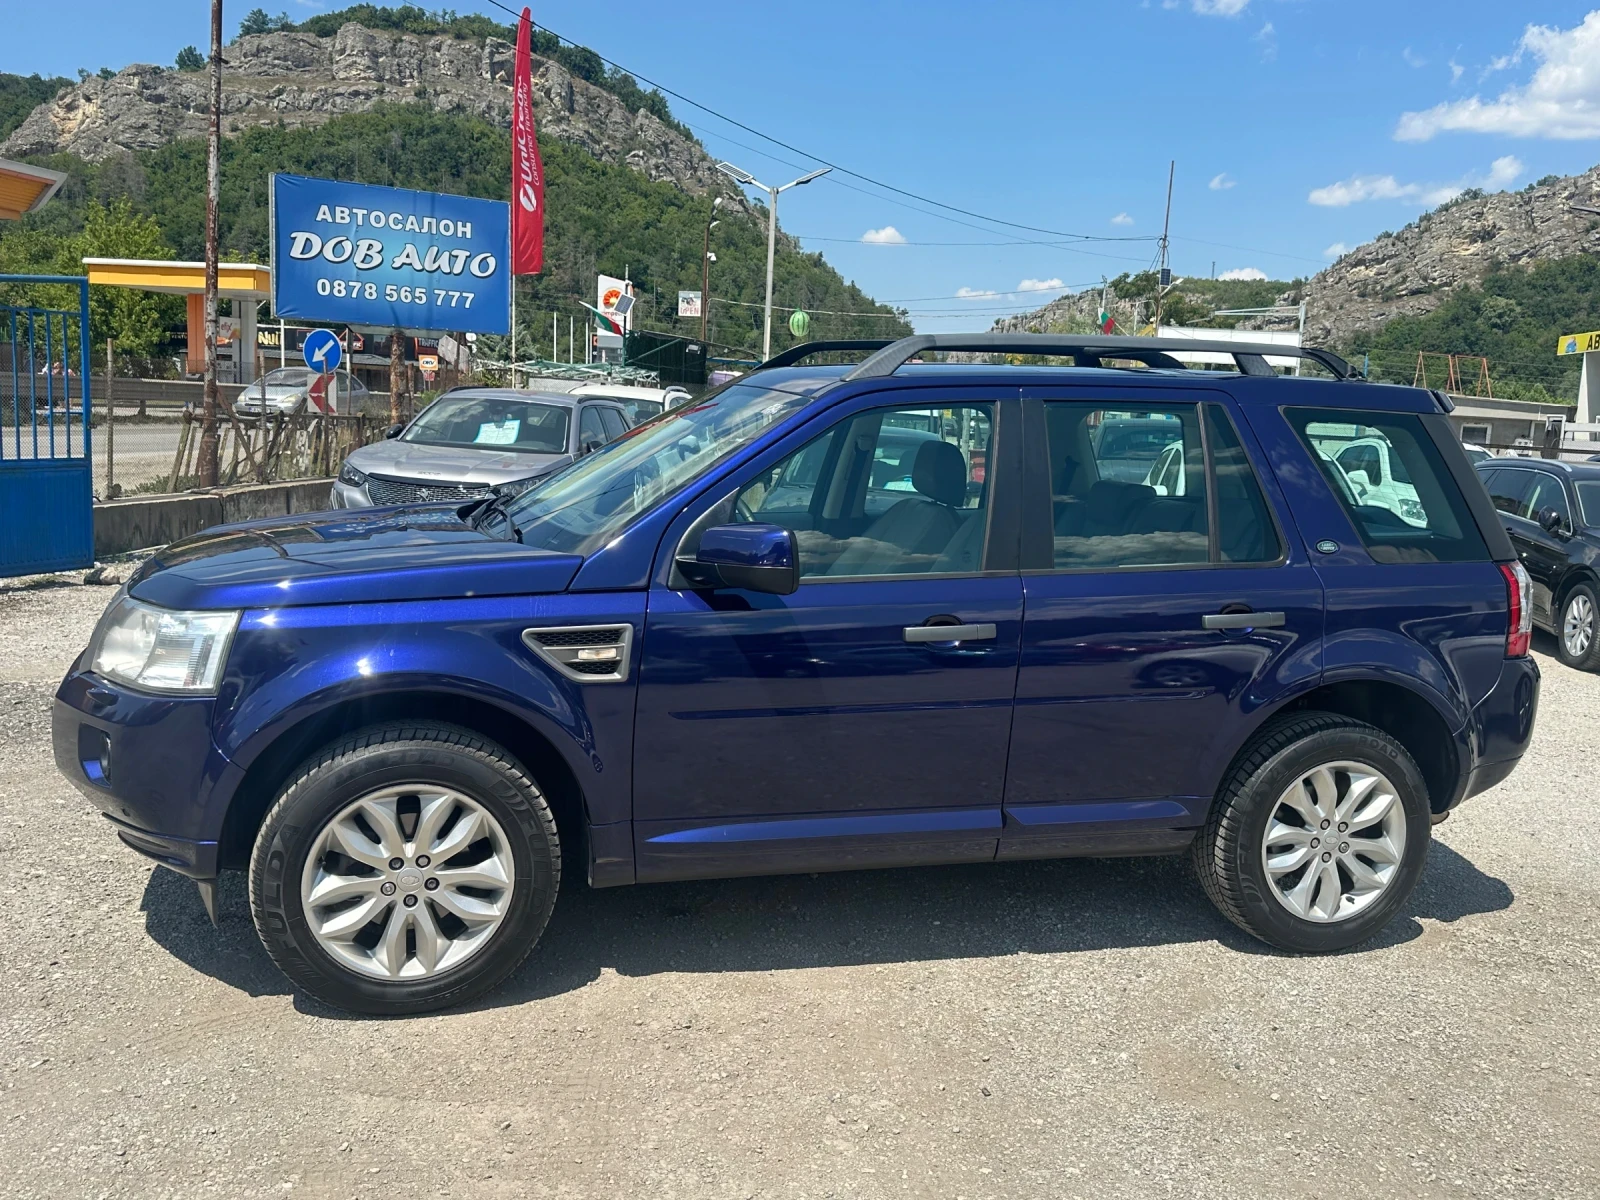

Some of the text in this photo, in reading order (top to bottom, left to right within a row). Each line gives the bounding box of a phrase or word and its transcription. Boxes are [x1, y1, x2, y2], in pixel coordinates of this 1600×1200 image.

[315, 204, 472, 239] АВТОСАЛОН
[289, 231, 497, 278] DOB AUTO
[316, 278, 475, 309] 0878 565 777
[263, 823, 300, 956] FULDA
